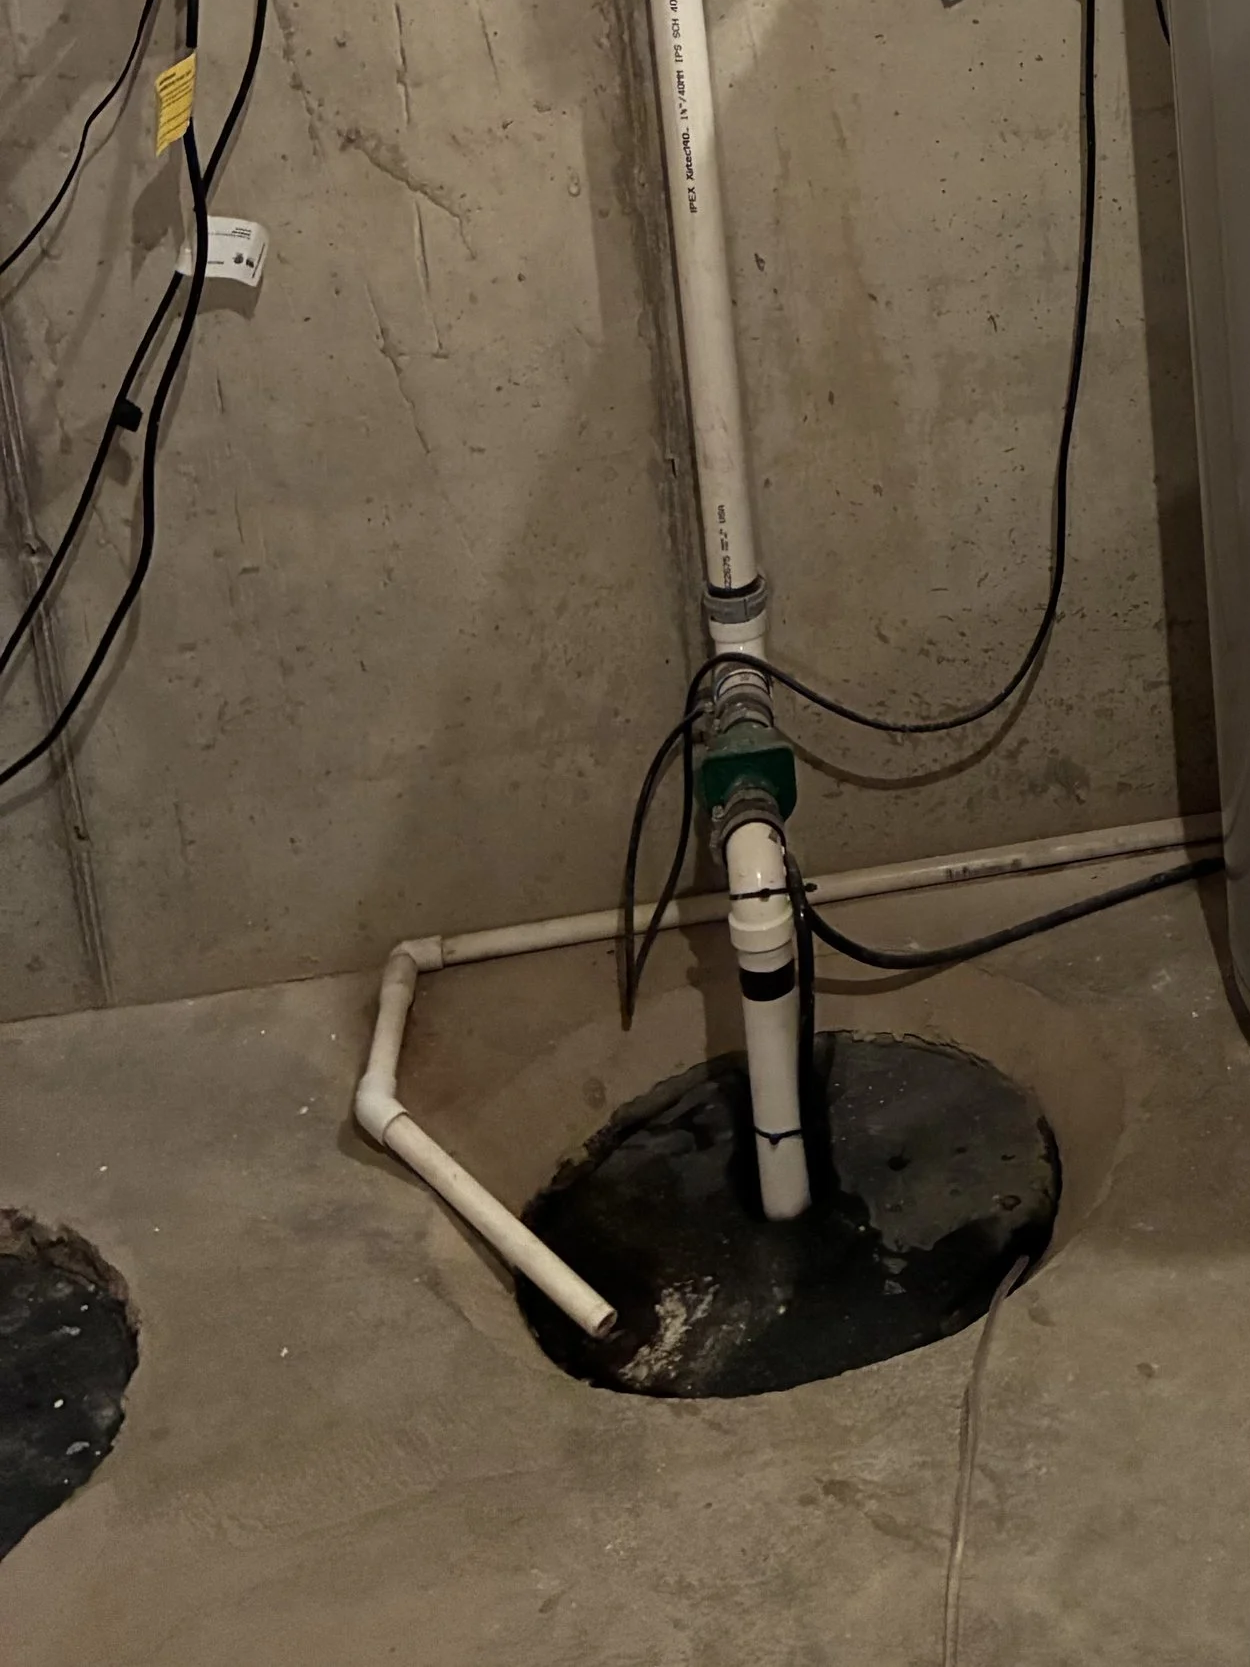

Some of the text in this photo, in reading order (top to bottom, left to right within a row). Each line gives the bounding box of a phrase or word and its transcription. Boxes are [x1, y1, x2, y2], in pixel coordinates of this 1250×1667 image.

[670, 18, 681, 38] SCH
[673, 44, 683, 62] IPS
[687, 186, 698, 213] IPEX
